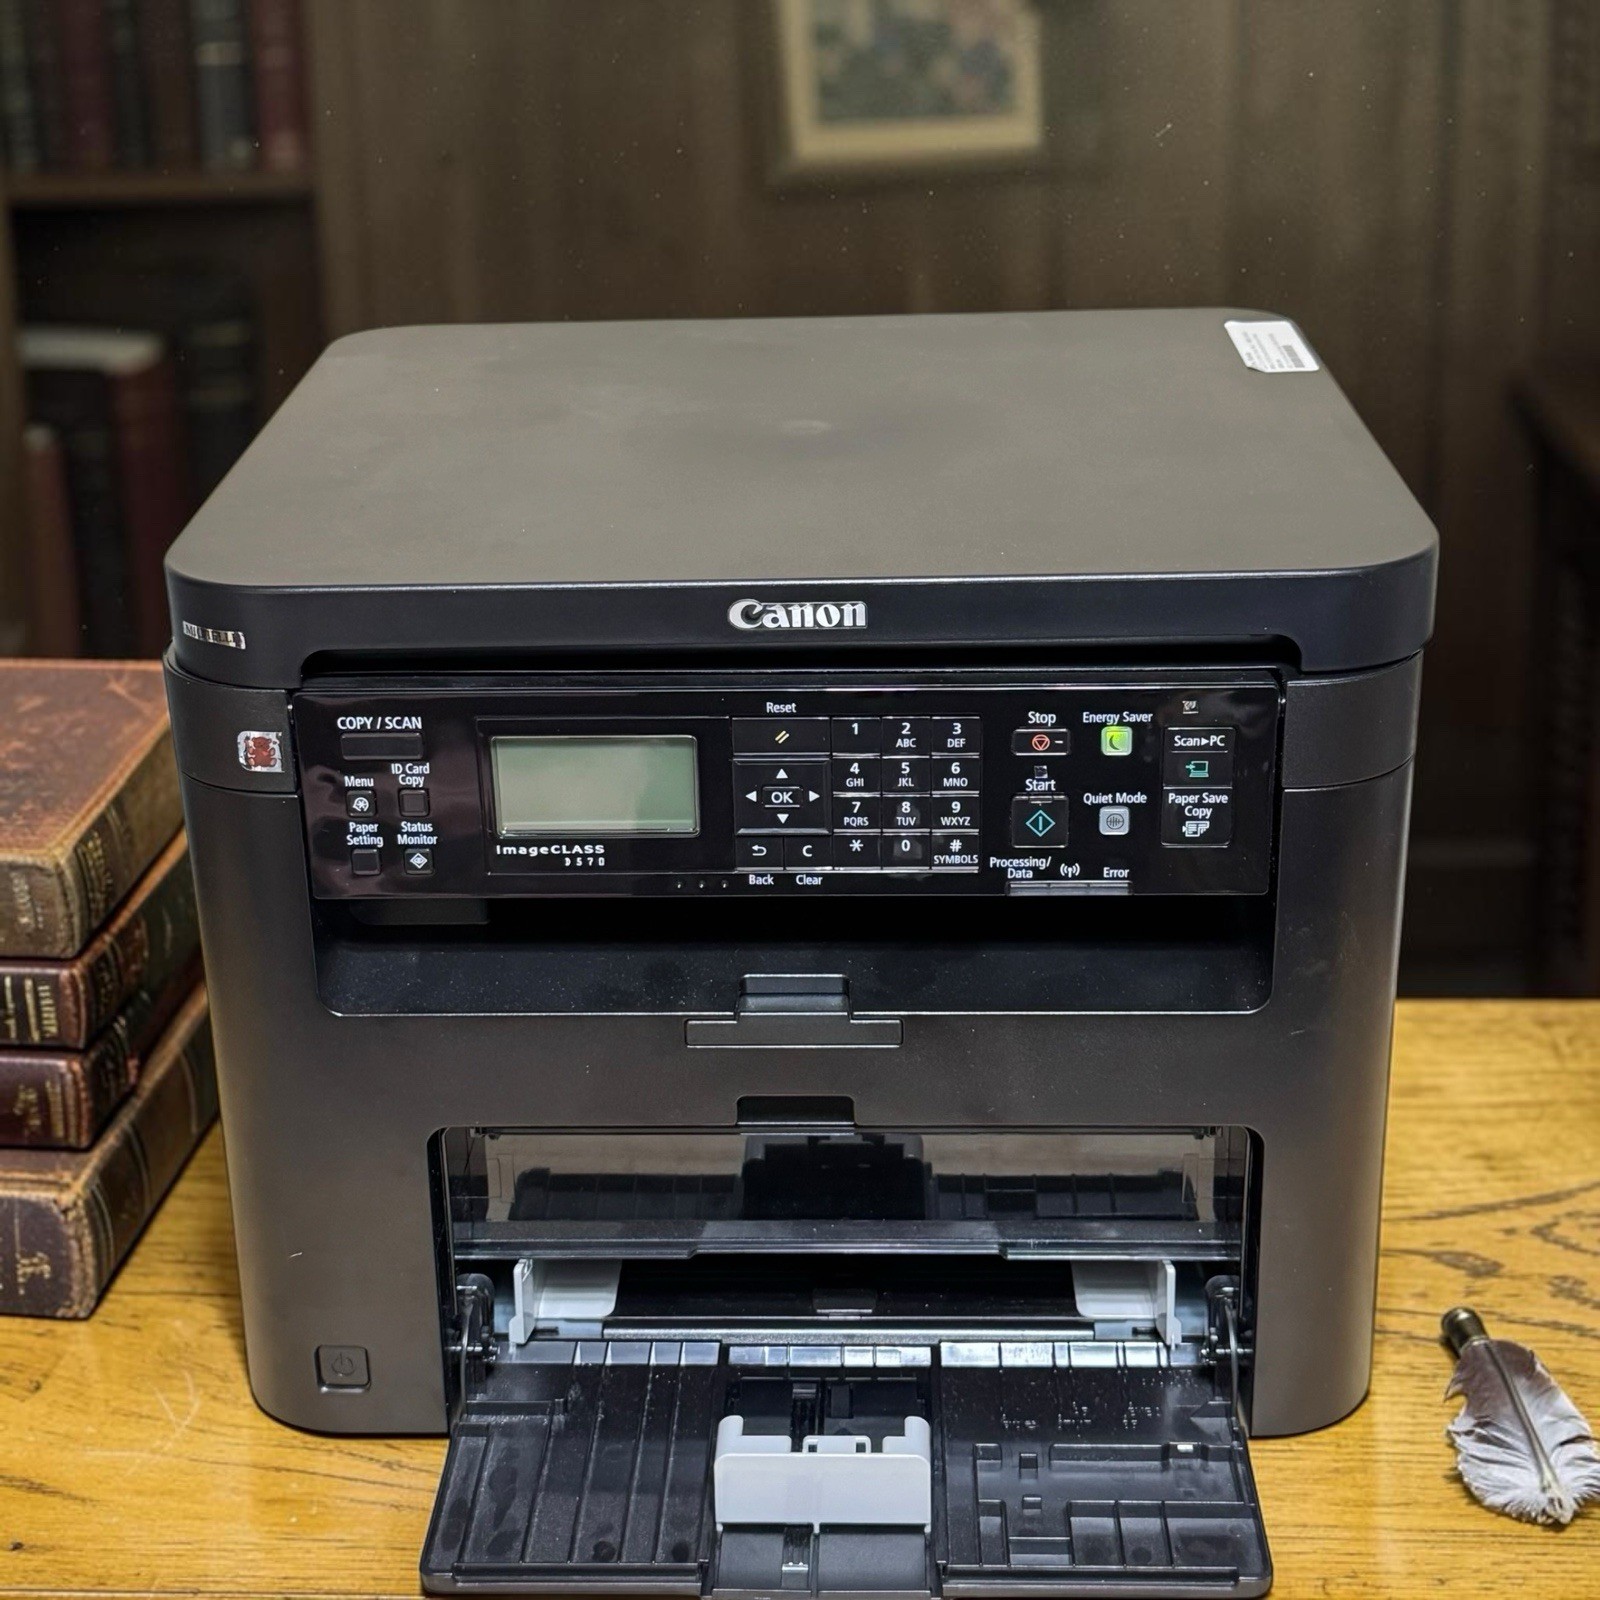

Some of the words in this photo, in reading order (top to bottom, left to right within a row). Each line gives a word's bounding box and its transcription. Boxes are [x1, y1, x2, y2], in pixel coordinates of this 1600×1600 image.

[727, 598, 867, 631] Canon
[766, 701, 797, 714] Reset
[336, 716, 374, 730] COPY
[384, 716, 423, 730] SCAN
[1027, 710, 1057, 727] Stop
[1082, 711, 1121, 726] Energy
[1122, 711, 1154, 723] Saver
[851, 722, 859, 735] 1
[901, 721, 911, 735] 2
[952, 722, 962, 735] 3
[895, 737, 917, 748] ABC
[946, 737, 966, 748] DEF
[391, 762, 403, 775] ID
[405, 762, 431, 775] Card
[849, 762, 861, 775] 4
[901, 761, 911, 775] 5
[950, 761, 961, 775] 6
[343, 775, 375, 788] Menu
[398, 774, 425, 788] Copy
[845, 777, 865, 788] GHI
[897, 777, 915, 787] JKL
[942, 777, 969, 787] MNO
[1025, 778, 1057, 792] Start
[770, 791, 794, 804] OK
[1083, 792, 1113, 806] Quiet
[1115, 791, 1148, 804] Mode
[1168, 792, 1201, 806] Paper
[1201, 791, 1229, 804] Save
[851, 801, 862, 814] 7
[901, 801, 911, 814] 8
[951, 800, 961, 814] 9
[1184, 805, 1213, 819] Copy
[401, 821, 433, 833] Status
[843, 816, 869, 828] PQRS
[895, 816, 917, 827] TUV
[940, 816, 971, 826] WXYZ
[348, 822, 379, 836] Paper
[346, 834, 384, 848] Setting
[397, 834, 438, 846] Monitor
[900, 839, 911, 852] 0
[949, 838, 963, 853] #
[802, 844, 813, 858] C
[933, 854, 979, 865] SYMBOLS
[989, 855, 1052, 870] Processing/
[1007, 867, 1034, 879] Data
[1103, 866, 1130, 878] Error
[748, 873, 775, 886] Back
[795, 873, 823, 886] Clear
